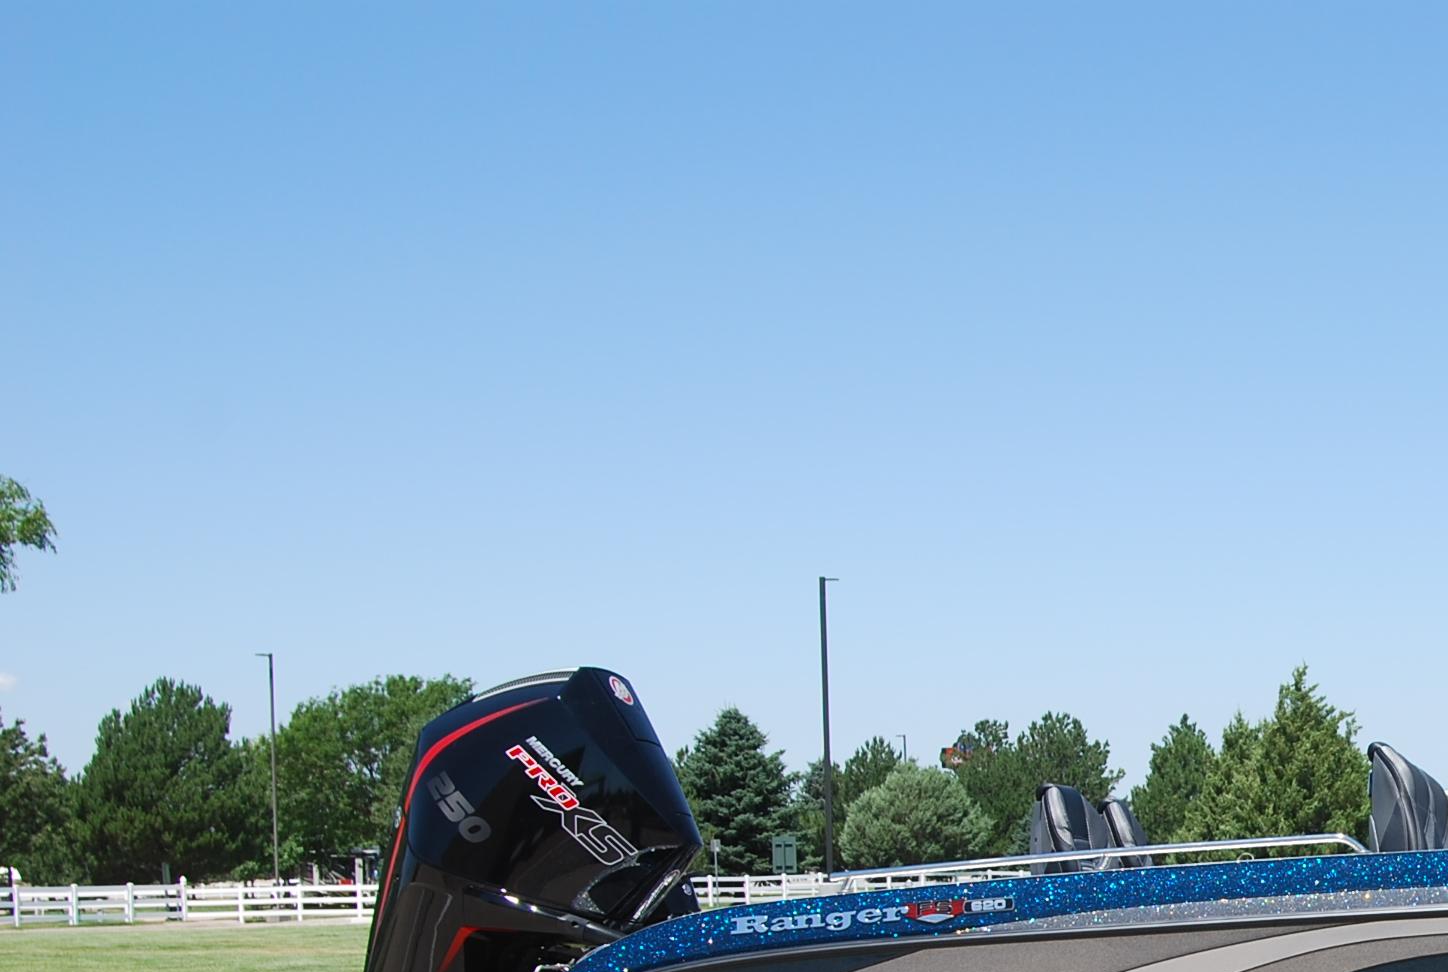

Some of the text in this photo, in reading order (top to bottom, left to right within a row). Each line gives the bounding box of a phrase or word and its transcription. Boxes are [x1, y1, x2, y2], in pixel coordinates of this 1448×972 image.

[525, 735, 583, 787] MERCURY
[426, 770, 492, 843] 250
[505, 744, 639, 865] PRO XS
[730, 905, 909, 935] Ranger
[970, 898, 1006, 912] 620
